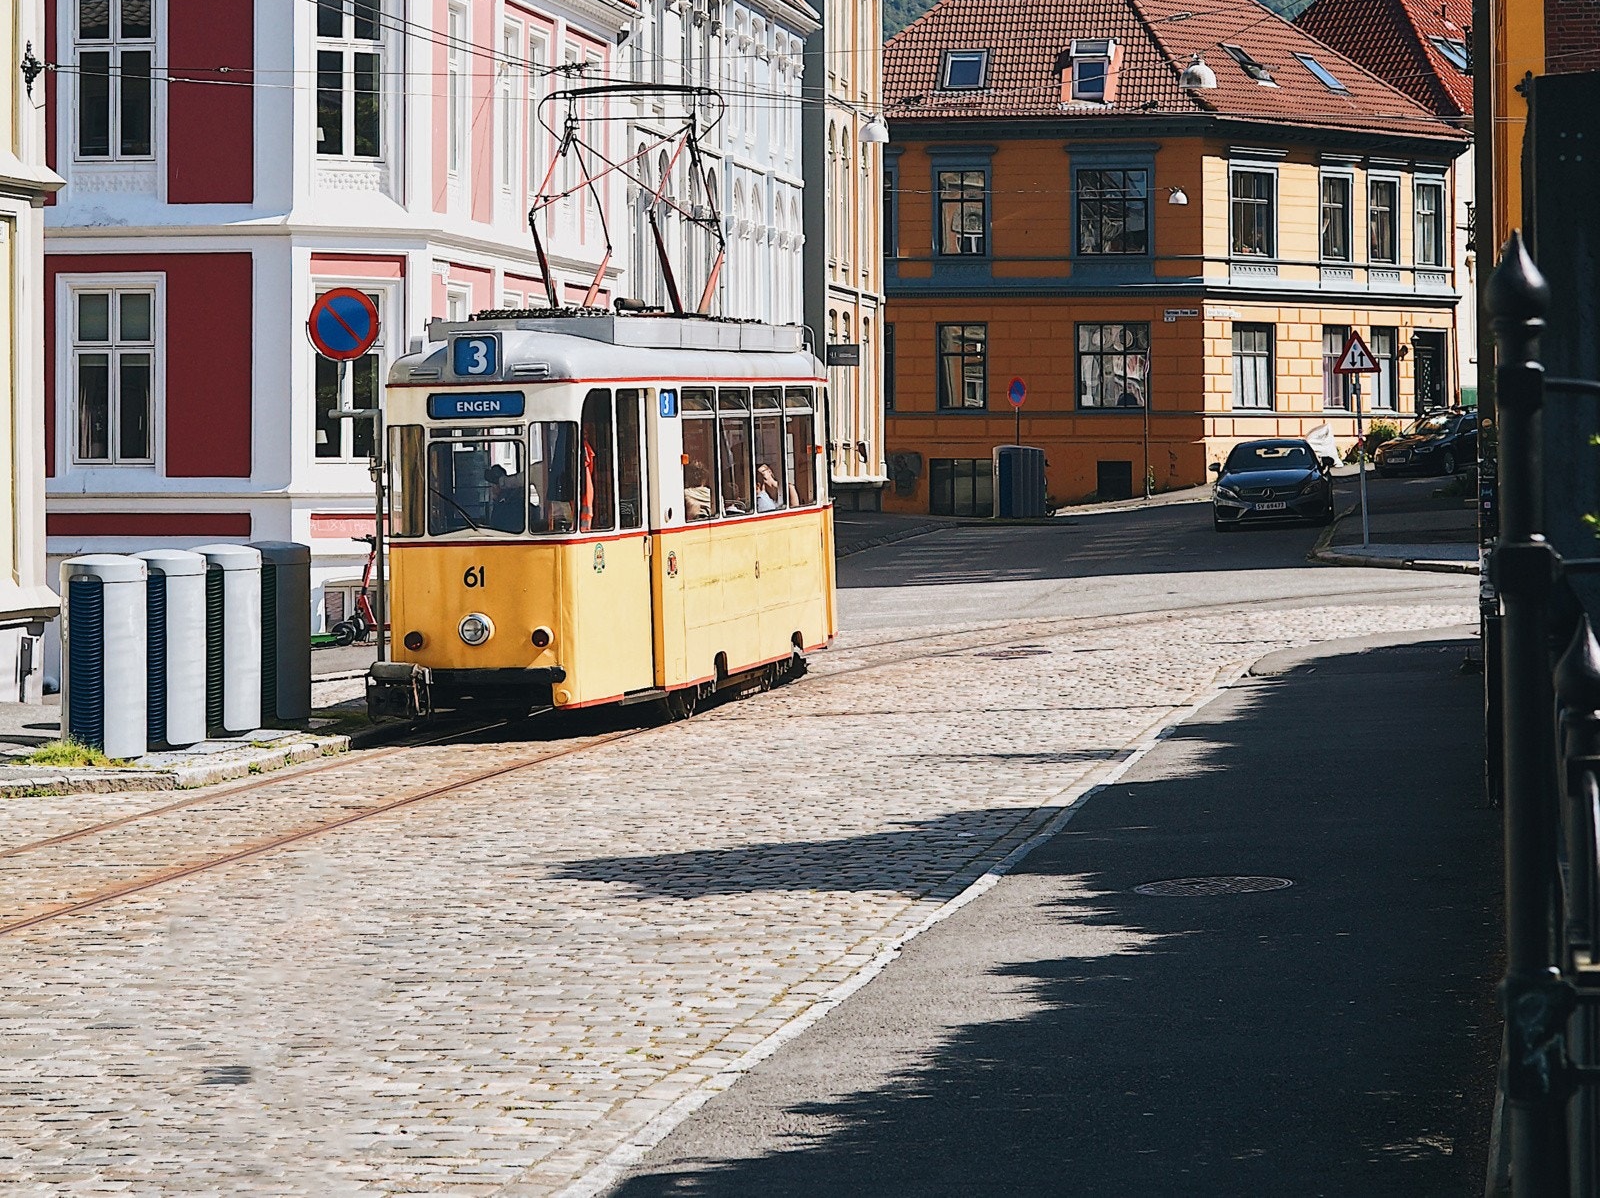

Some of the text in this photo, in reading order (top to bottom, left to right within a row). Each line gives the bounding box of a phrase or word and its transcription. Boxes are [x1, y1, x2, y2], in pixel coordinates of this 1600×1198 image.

[467, 340, 488, 374] 3
[456, 400, 500, 412] ENGEN
[663, 392, 669, 414] 3
[463, 565, 485, 588] 61
